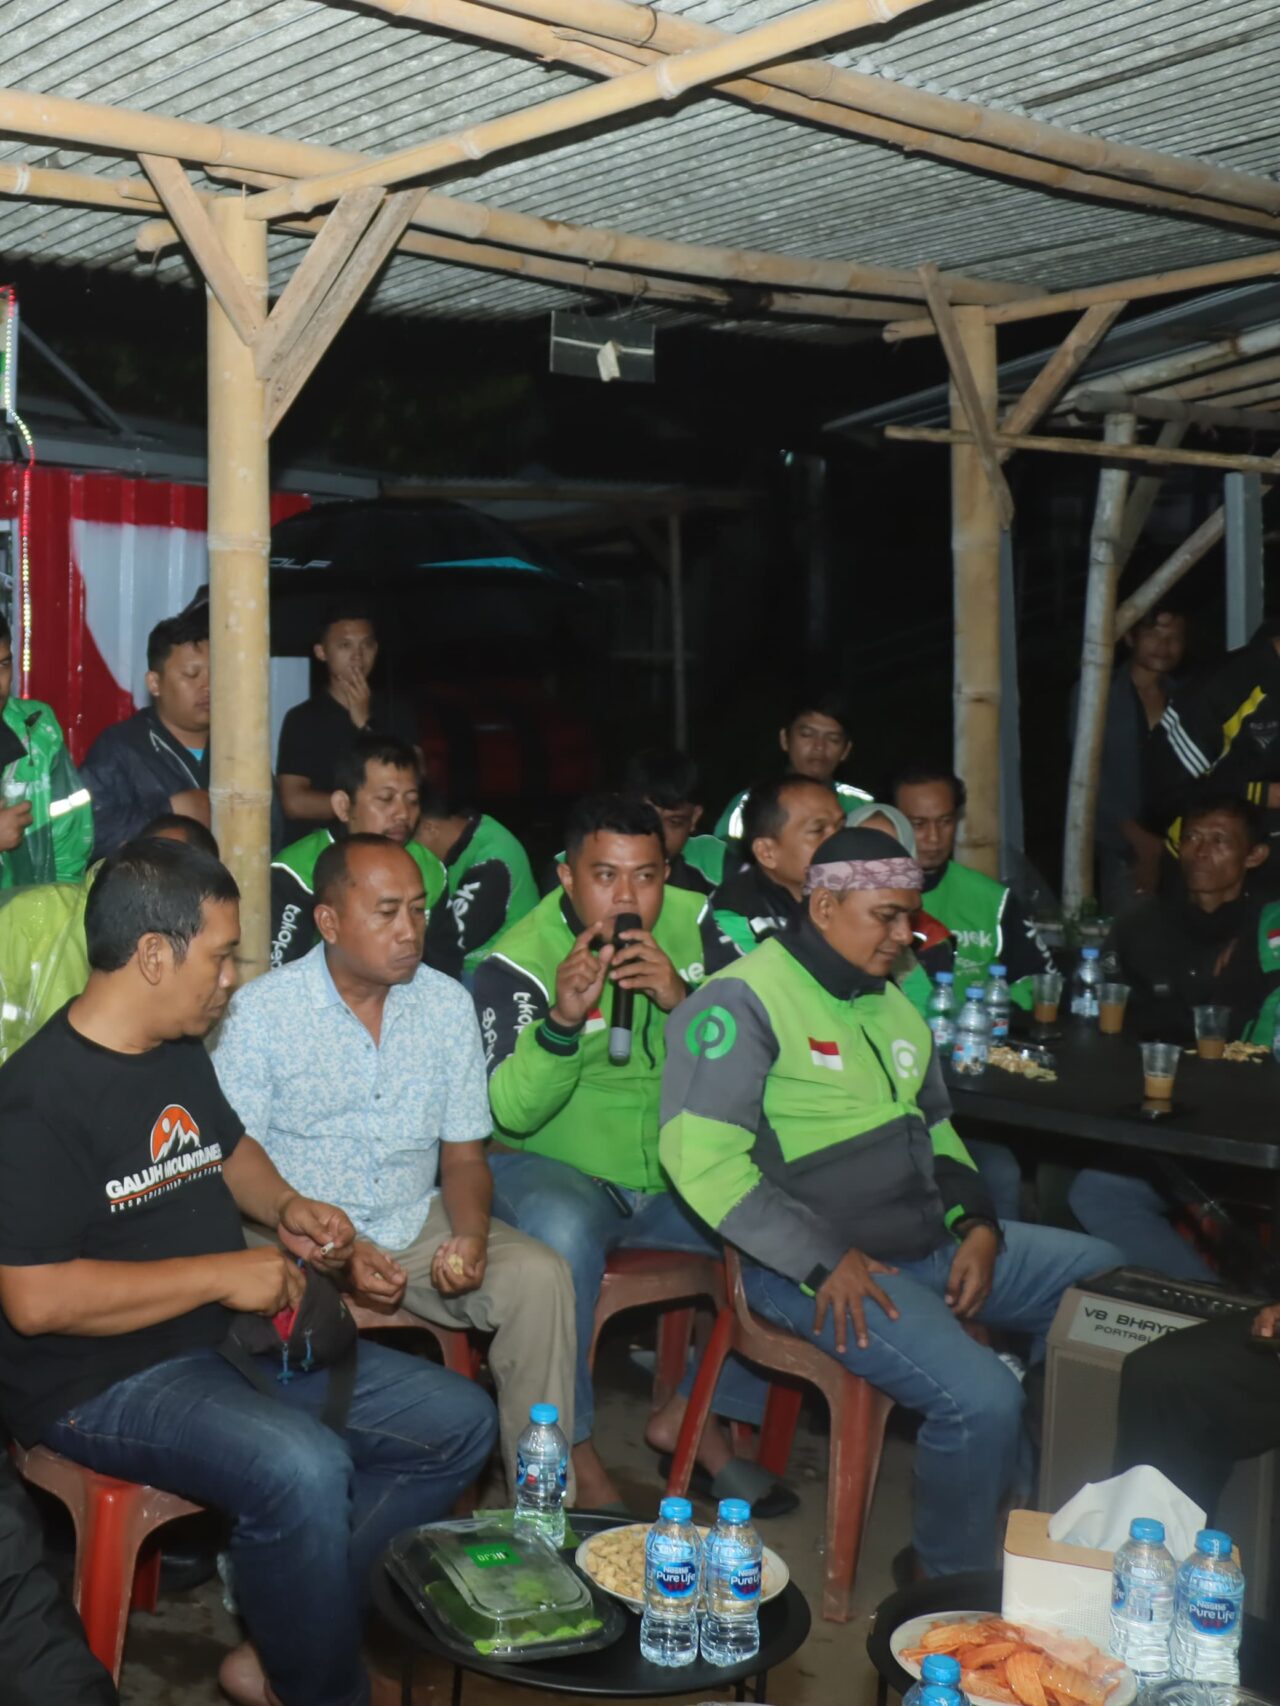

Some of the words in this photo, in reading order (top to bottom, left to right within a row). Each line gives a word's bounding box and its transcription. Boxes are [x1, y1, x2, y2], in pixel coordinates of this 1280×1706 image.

[105, 1163, 163, 1199] GALUH
[1084, 1307, 1108, 1321] V8
[656, 1571, 680, 1583] Pure
[730, 1575, 752, 1585] Pure
[1189, 1604, 1216, 1619] Pure
[1217, 1609, 1235, 1623] Life
